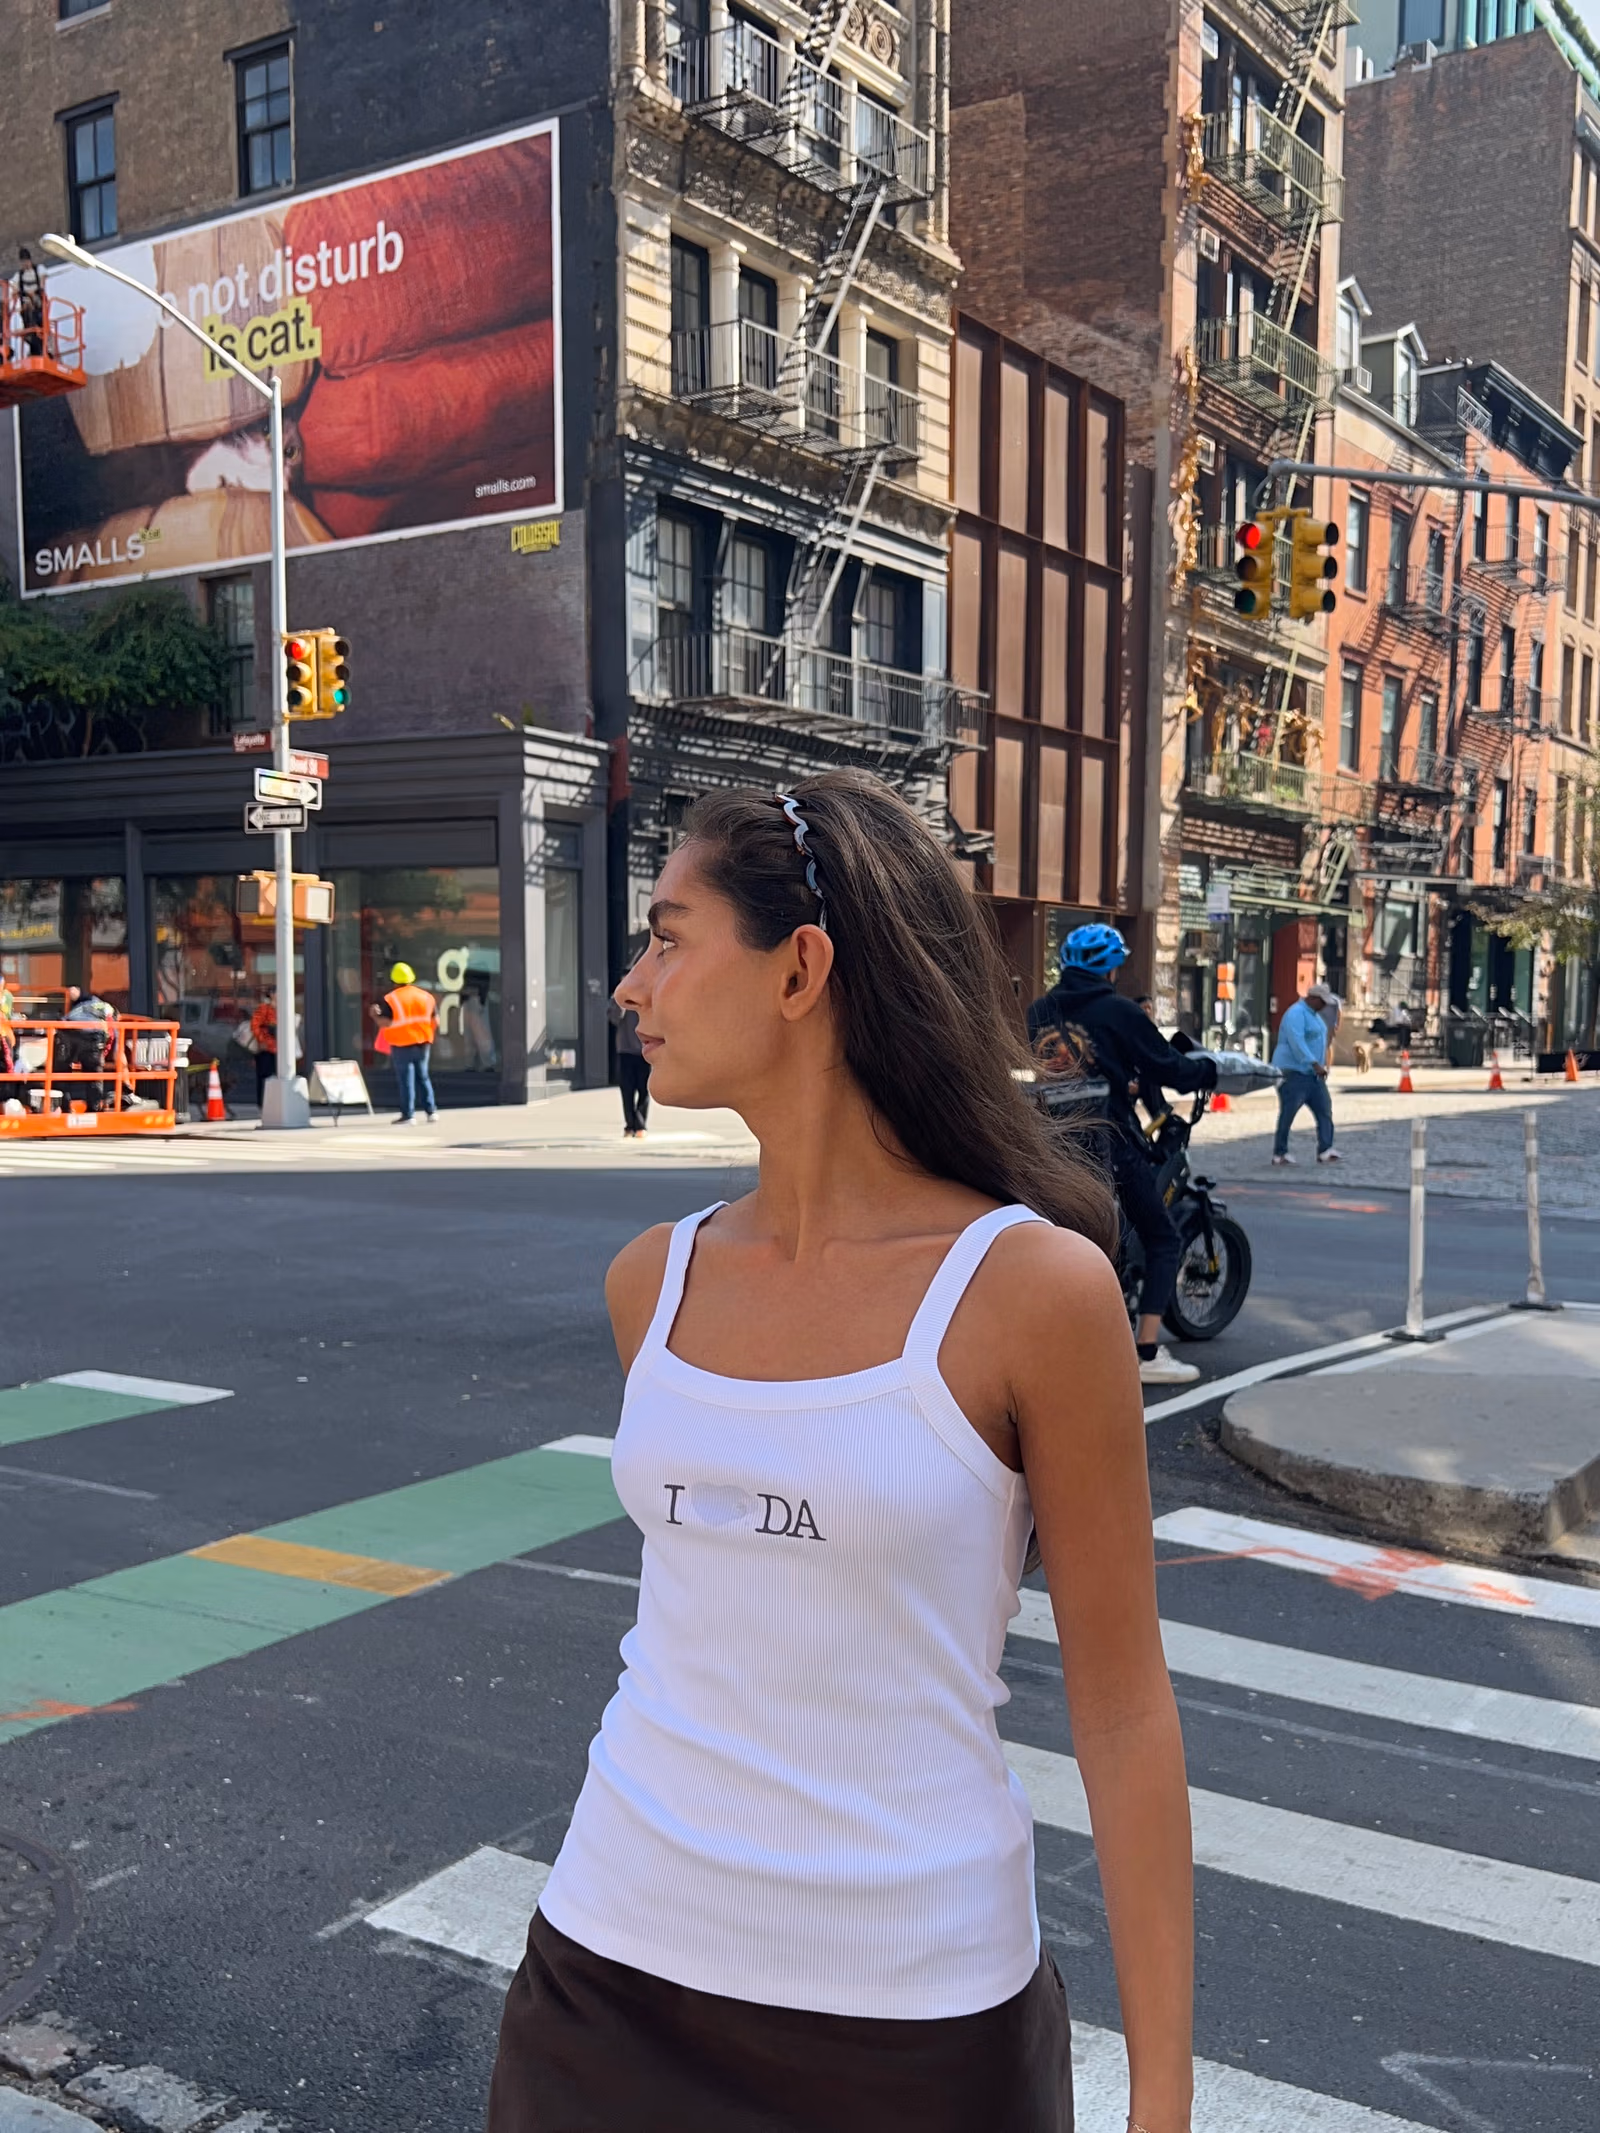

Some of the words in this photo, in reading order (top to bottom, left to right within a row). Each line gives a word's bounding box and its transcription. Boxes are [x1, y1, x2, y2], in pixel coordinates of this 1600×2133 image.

[188, 263, 249, 320] not
[259, 220, 404, 302] disturb
[207, 325, 238, 372] is
[248, 308, 315, 361] cat.
[475, 475, 537, 498] smalls.com
[35, 533, 146, 576] SMALLS
[664, 1484, 685, 1525] I
[755, 1493, 827, 1541] DA
